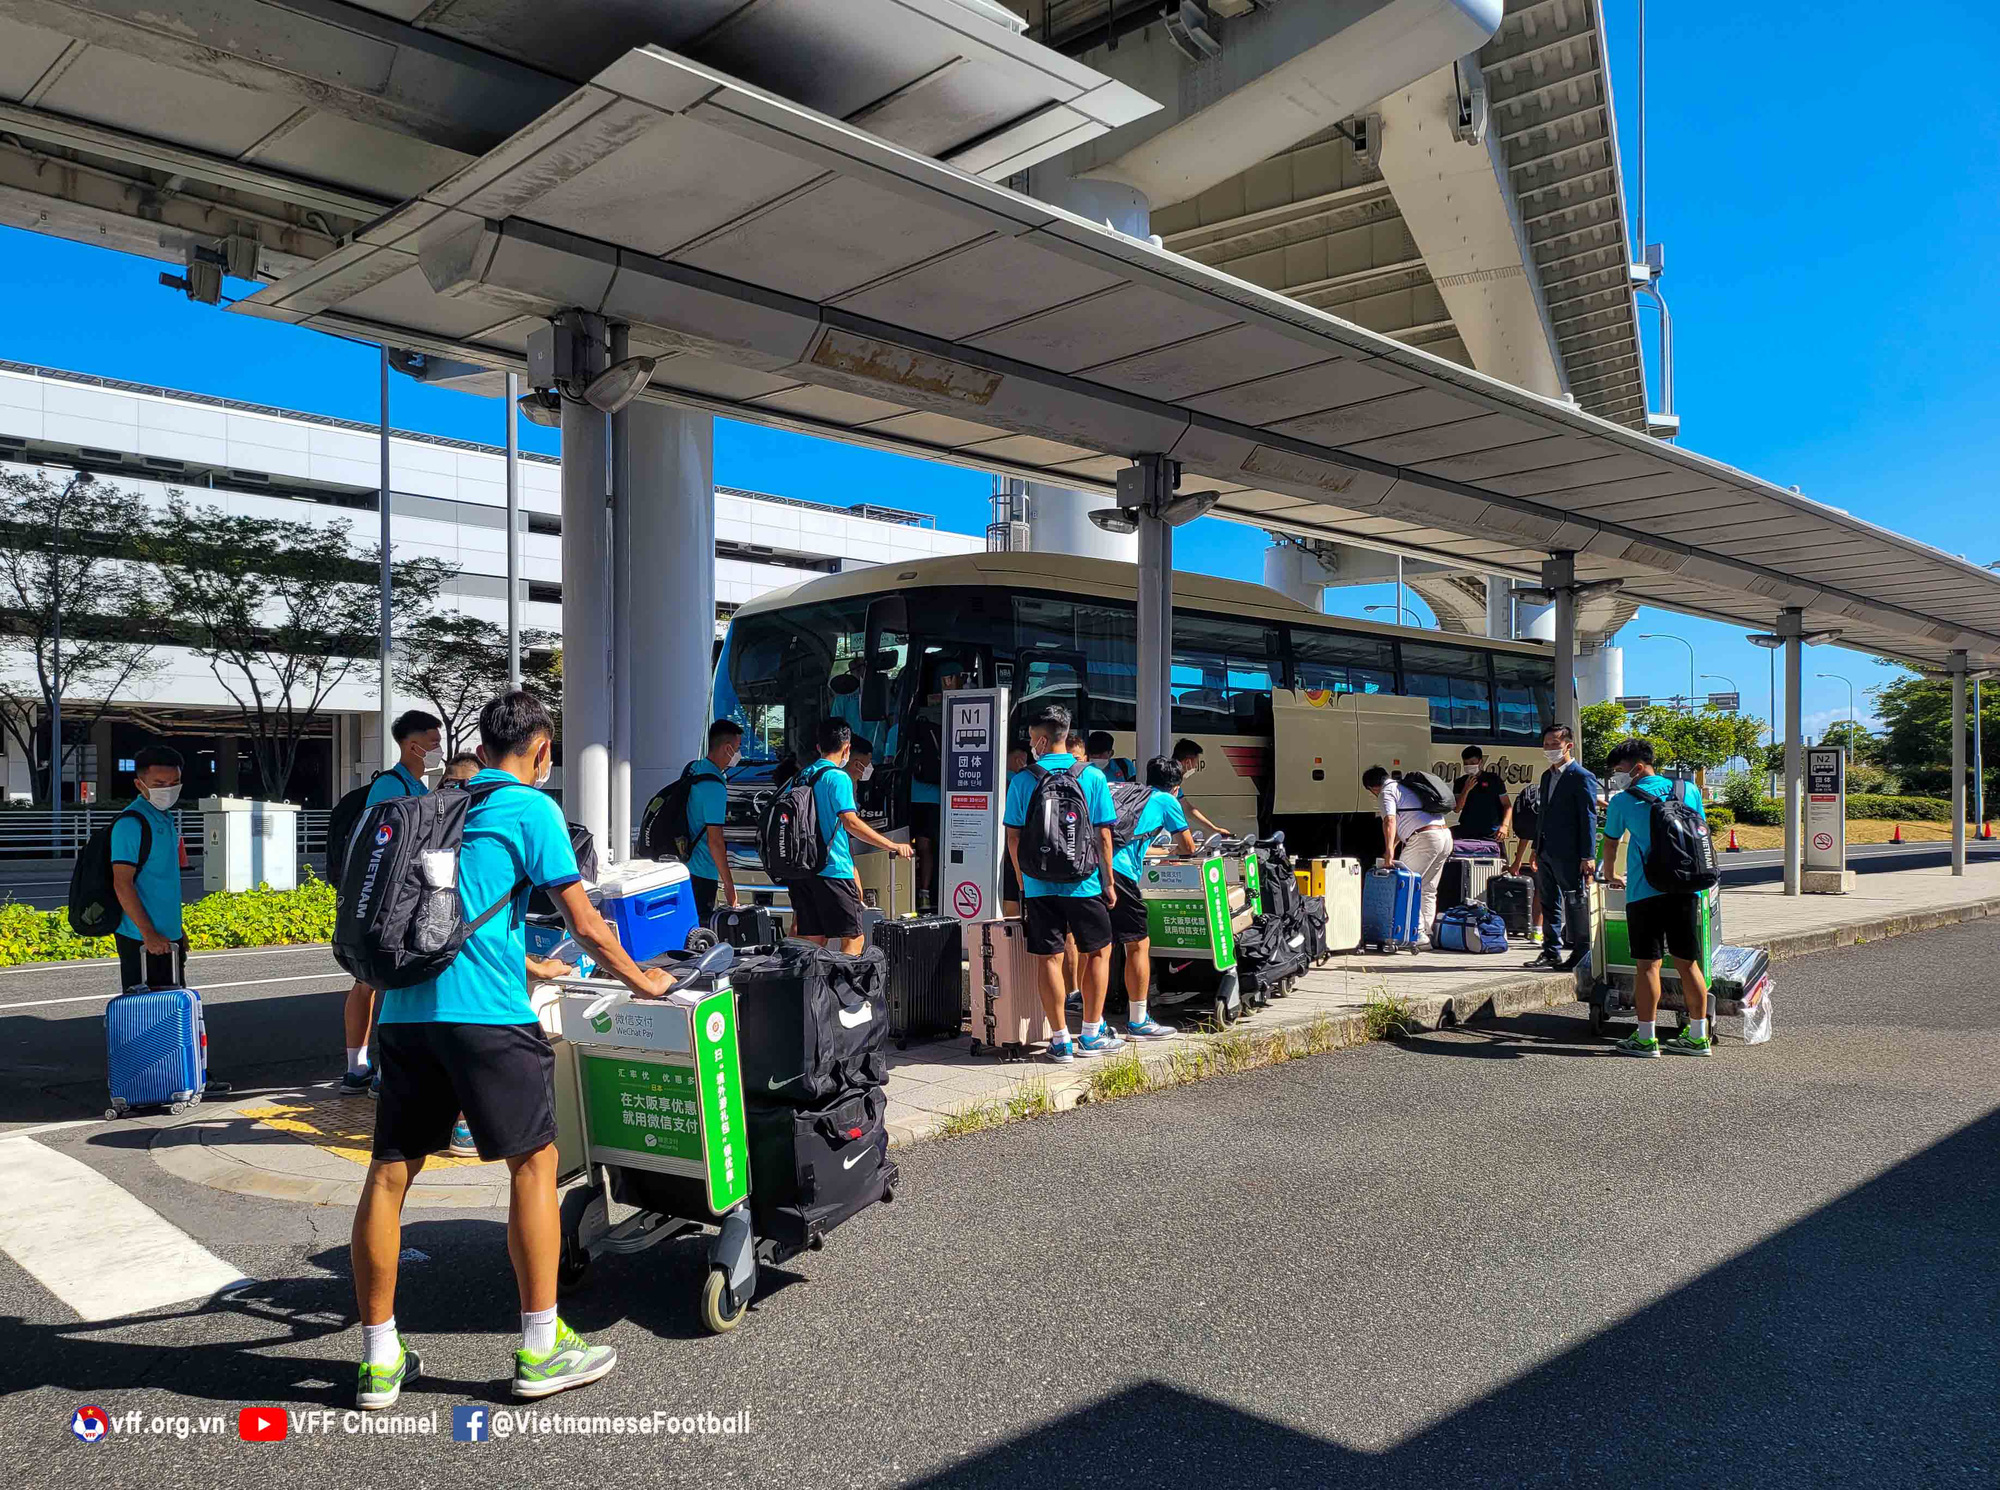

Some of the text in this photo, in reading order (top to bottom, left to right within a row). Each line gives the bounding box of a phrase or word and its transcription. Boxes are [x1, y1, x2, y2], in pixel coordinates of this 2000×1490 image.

[961, 709, 980, 725] N1
[1816, 755, 1830, 763] N2
[958, 769, 981, 780] Group
[779, 824, 787, 858] VIETNAM
[1066, 822, 1076, 861] VIETNAM
[1702, 835, 1714, 869] VIETNAM
[356, 848, 385, 918] VIETNAM
[614, 1012, 653, 1028] 微信支付
[616, 1026, 654, 1039] WeChat Pay
[620, 1091, 697, 1116] 在大阪享优惠
[622, 1109, 698, 1134] 就用微信支付
